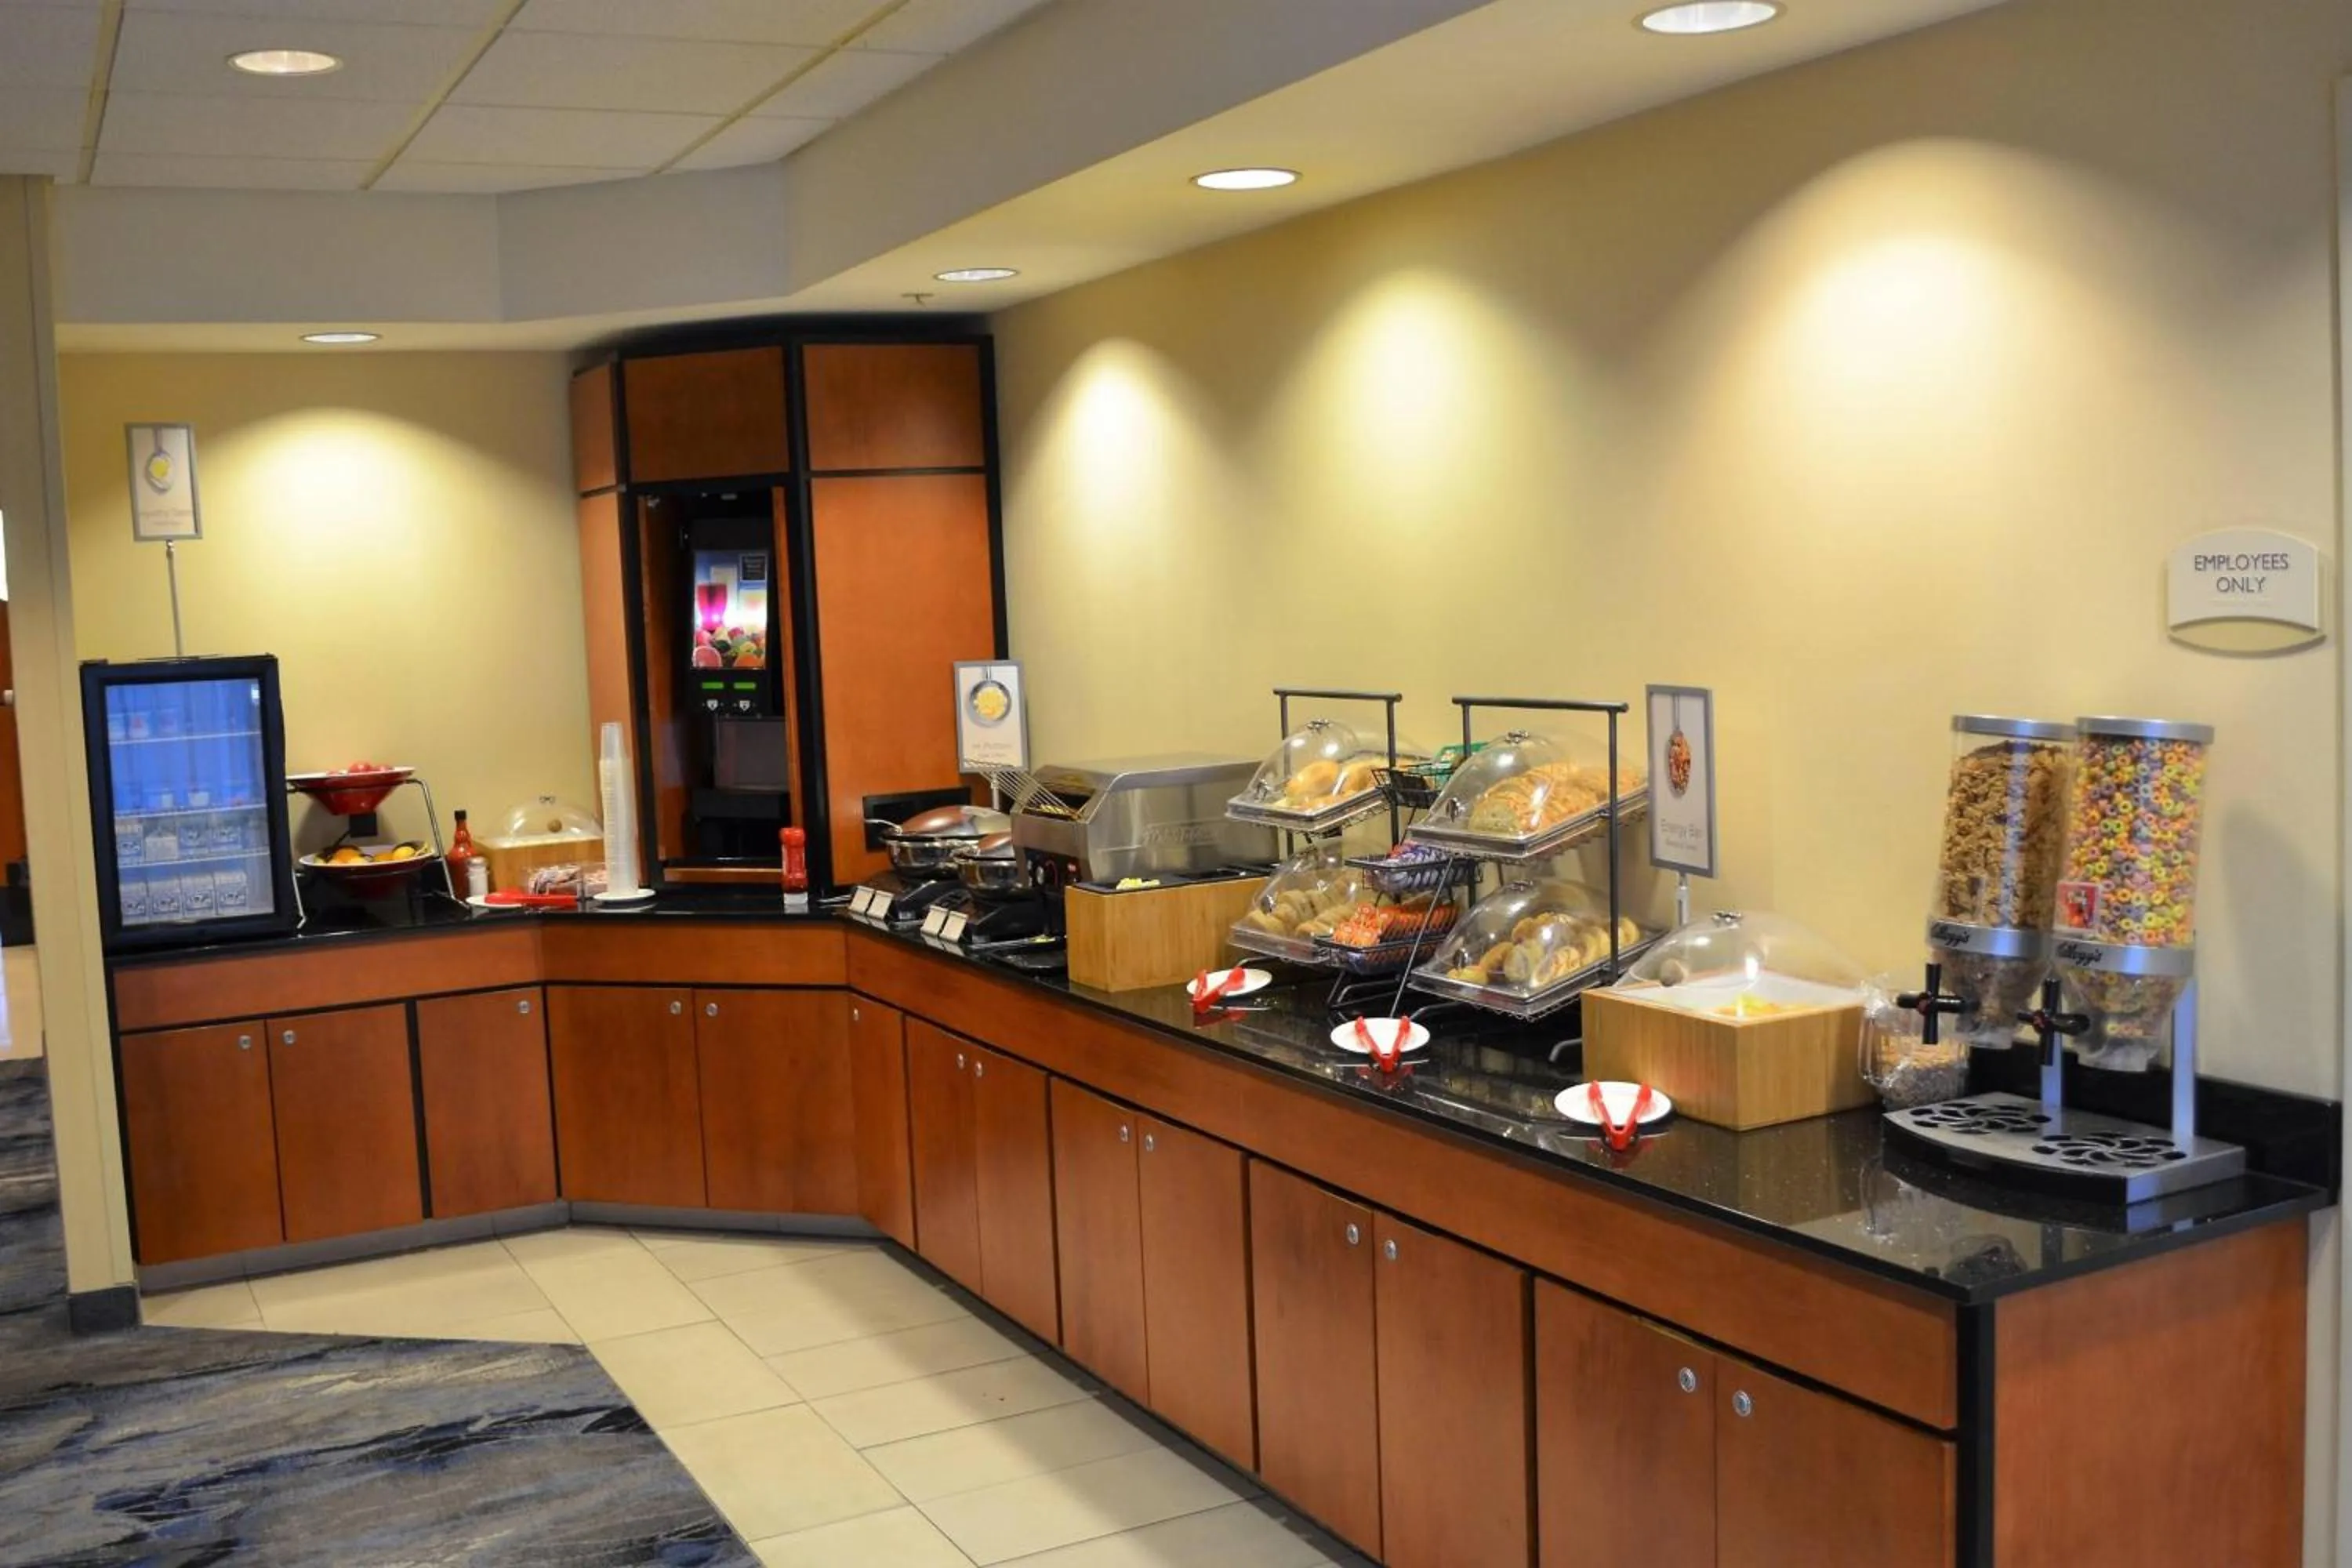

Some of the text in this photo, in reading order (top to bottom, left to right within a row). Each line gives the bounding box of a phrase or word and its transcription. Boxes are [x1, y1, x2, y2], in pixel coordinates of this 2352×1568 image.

[2194, 553, 2289, 571] EMPLOYEES
[2216, 576, 2266, 593] ONLY
[2056, 941, 2103, 967] Kellogg's
